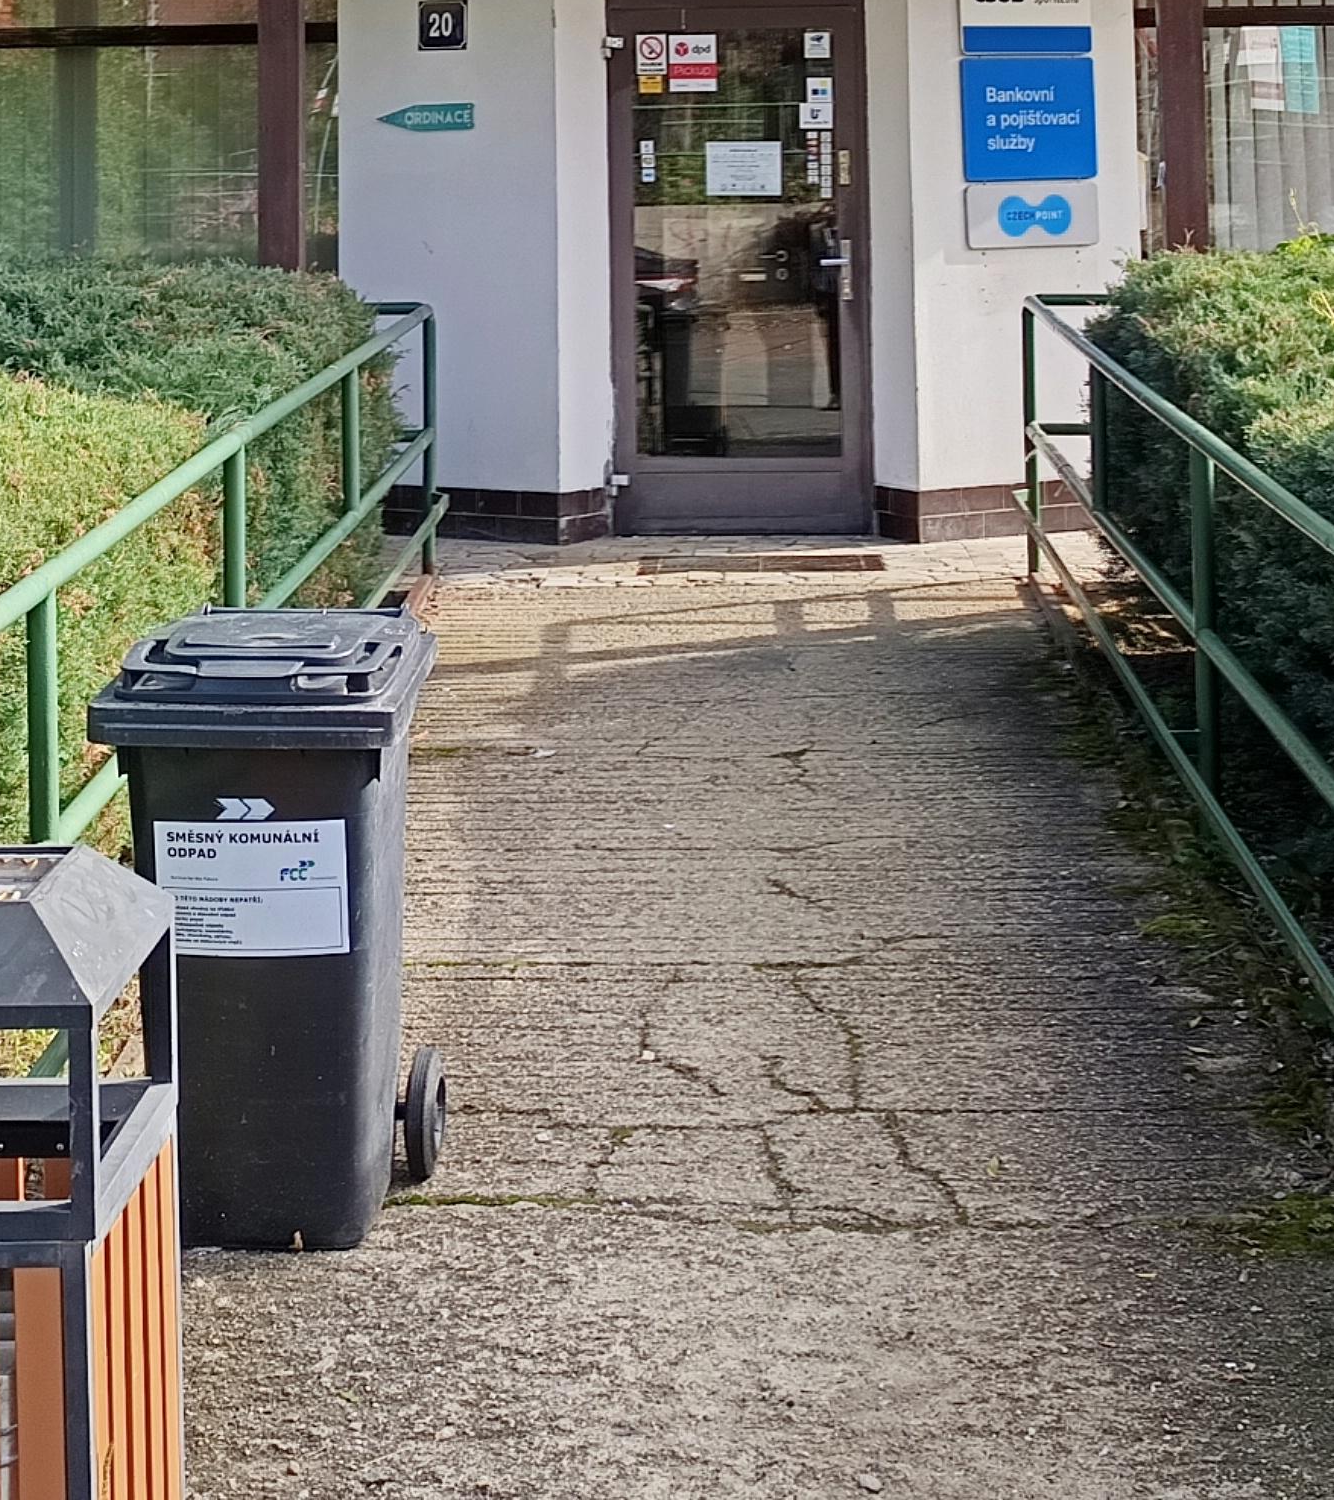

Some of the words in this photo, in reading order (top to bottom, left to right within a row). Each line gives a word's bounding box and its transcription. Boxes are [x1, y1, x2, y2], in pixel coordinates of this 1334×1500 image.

[429, 11, 452, 37] 20
[691, 44, 712, 55] dpd
[985, 86, 1055, 103] Bankovní
[404, 110, 471, 125] ORDINACE
[986, 113, 996, 127] a
[1000, 108, 1081, 130] pojišťovací
[987, 134, 1036, 153] služby
[166, 829, 224, 844] SMĚSNÝ
[228, 828, 320, 844] KOMUNÁLNÍ
[167, 846, 217, 859] ODPAD
[280, 867, 308, 882] FCC
[199, 895, 227, 903] NÁDOBY
